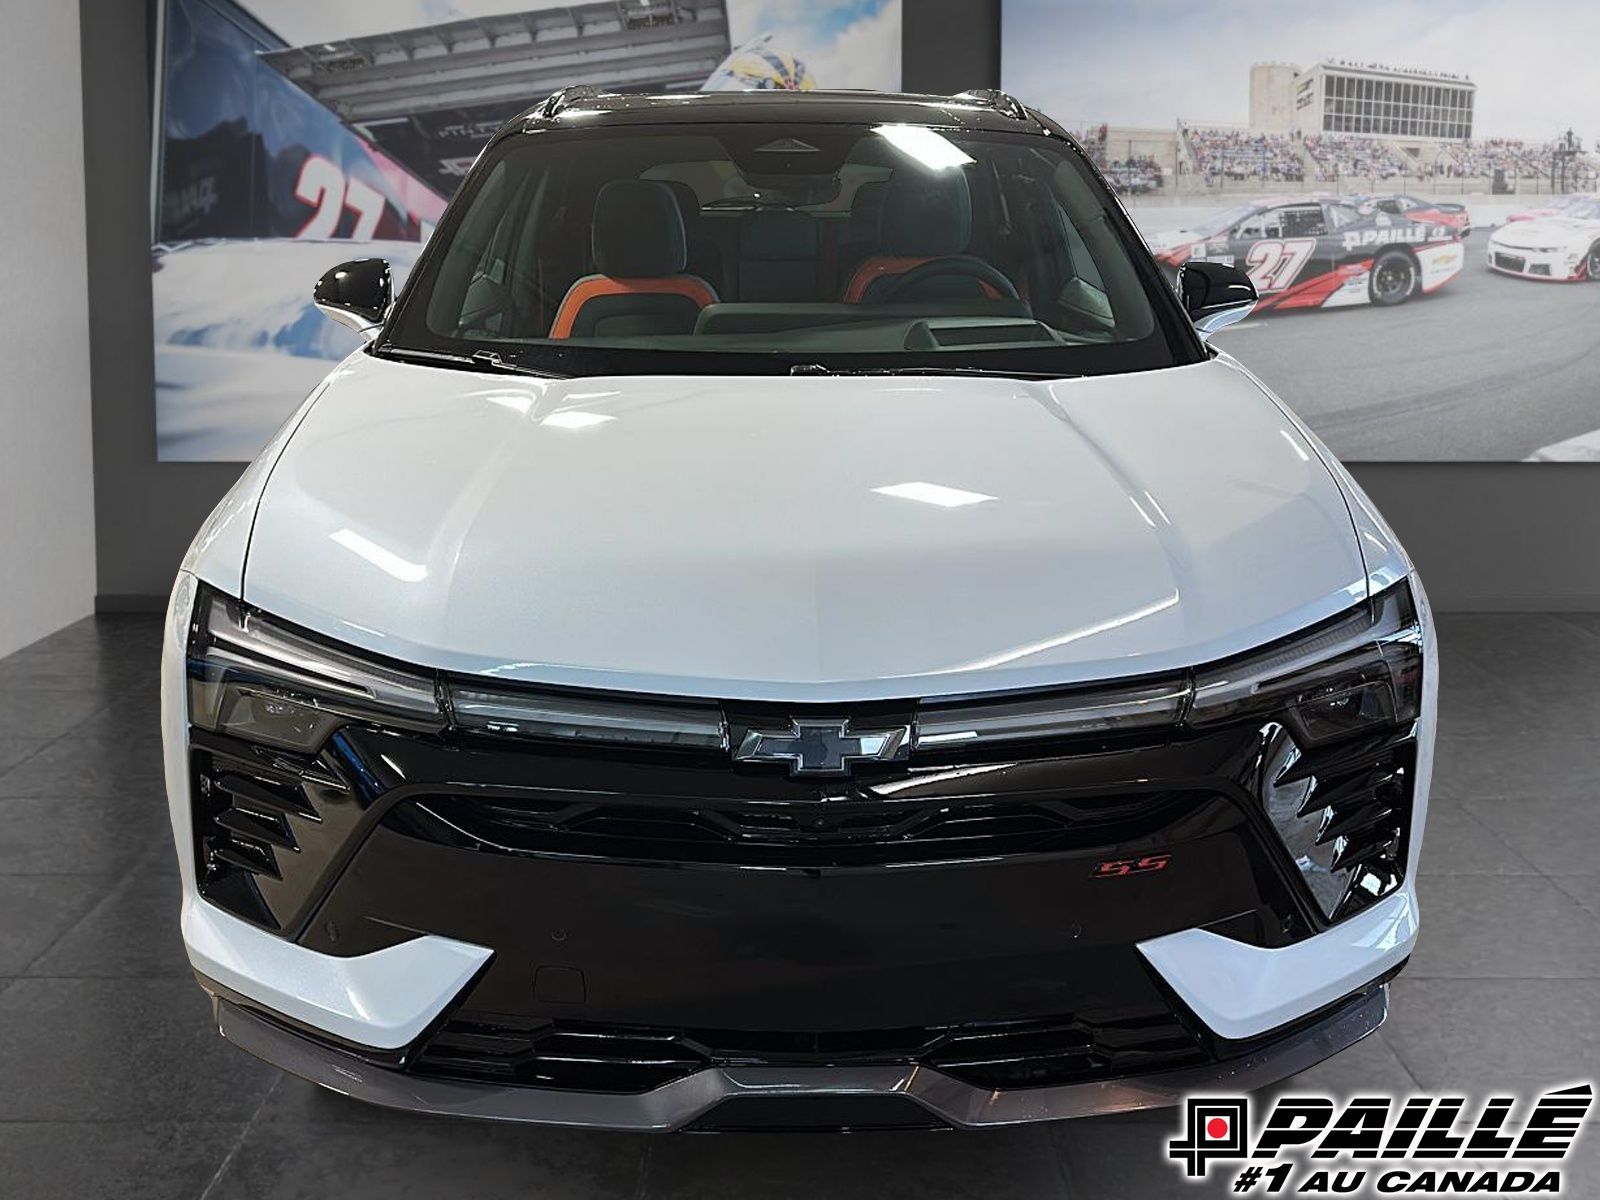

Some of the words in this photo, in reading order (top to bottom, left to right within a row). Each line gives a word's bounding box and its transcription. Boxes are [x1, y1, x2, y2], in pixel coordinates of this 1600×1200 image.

[294, 153, 386, 241] 27
[1246, 238, 1316, 293] 27
[1093, 853, 1171, 878] SS
